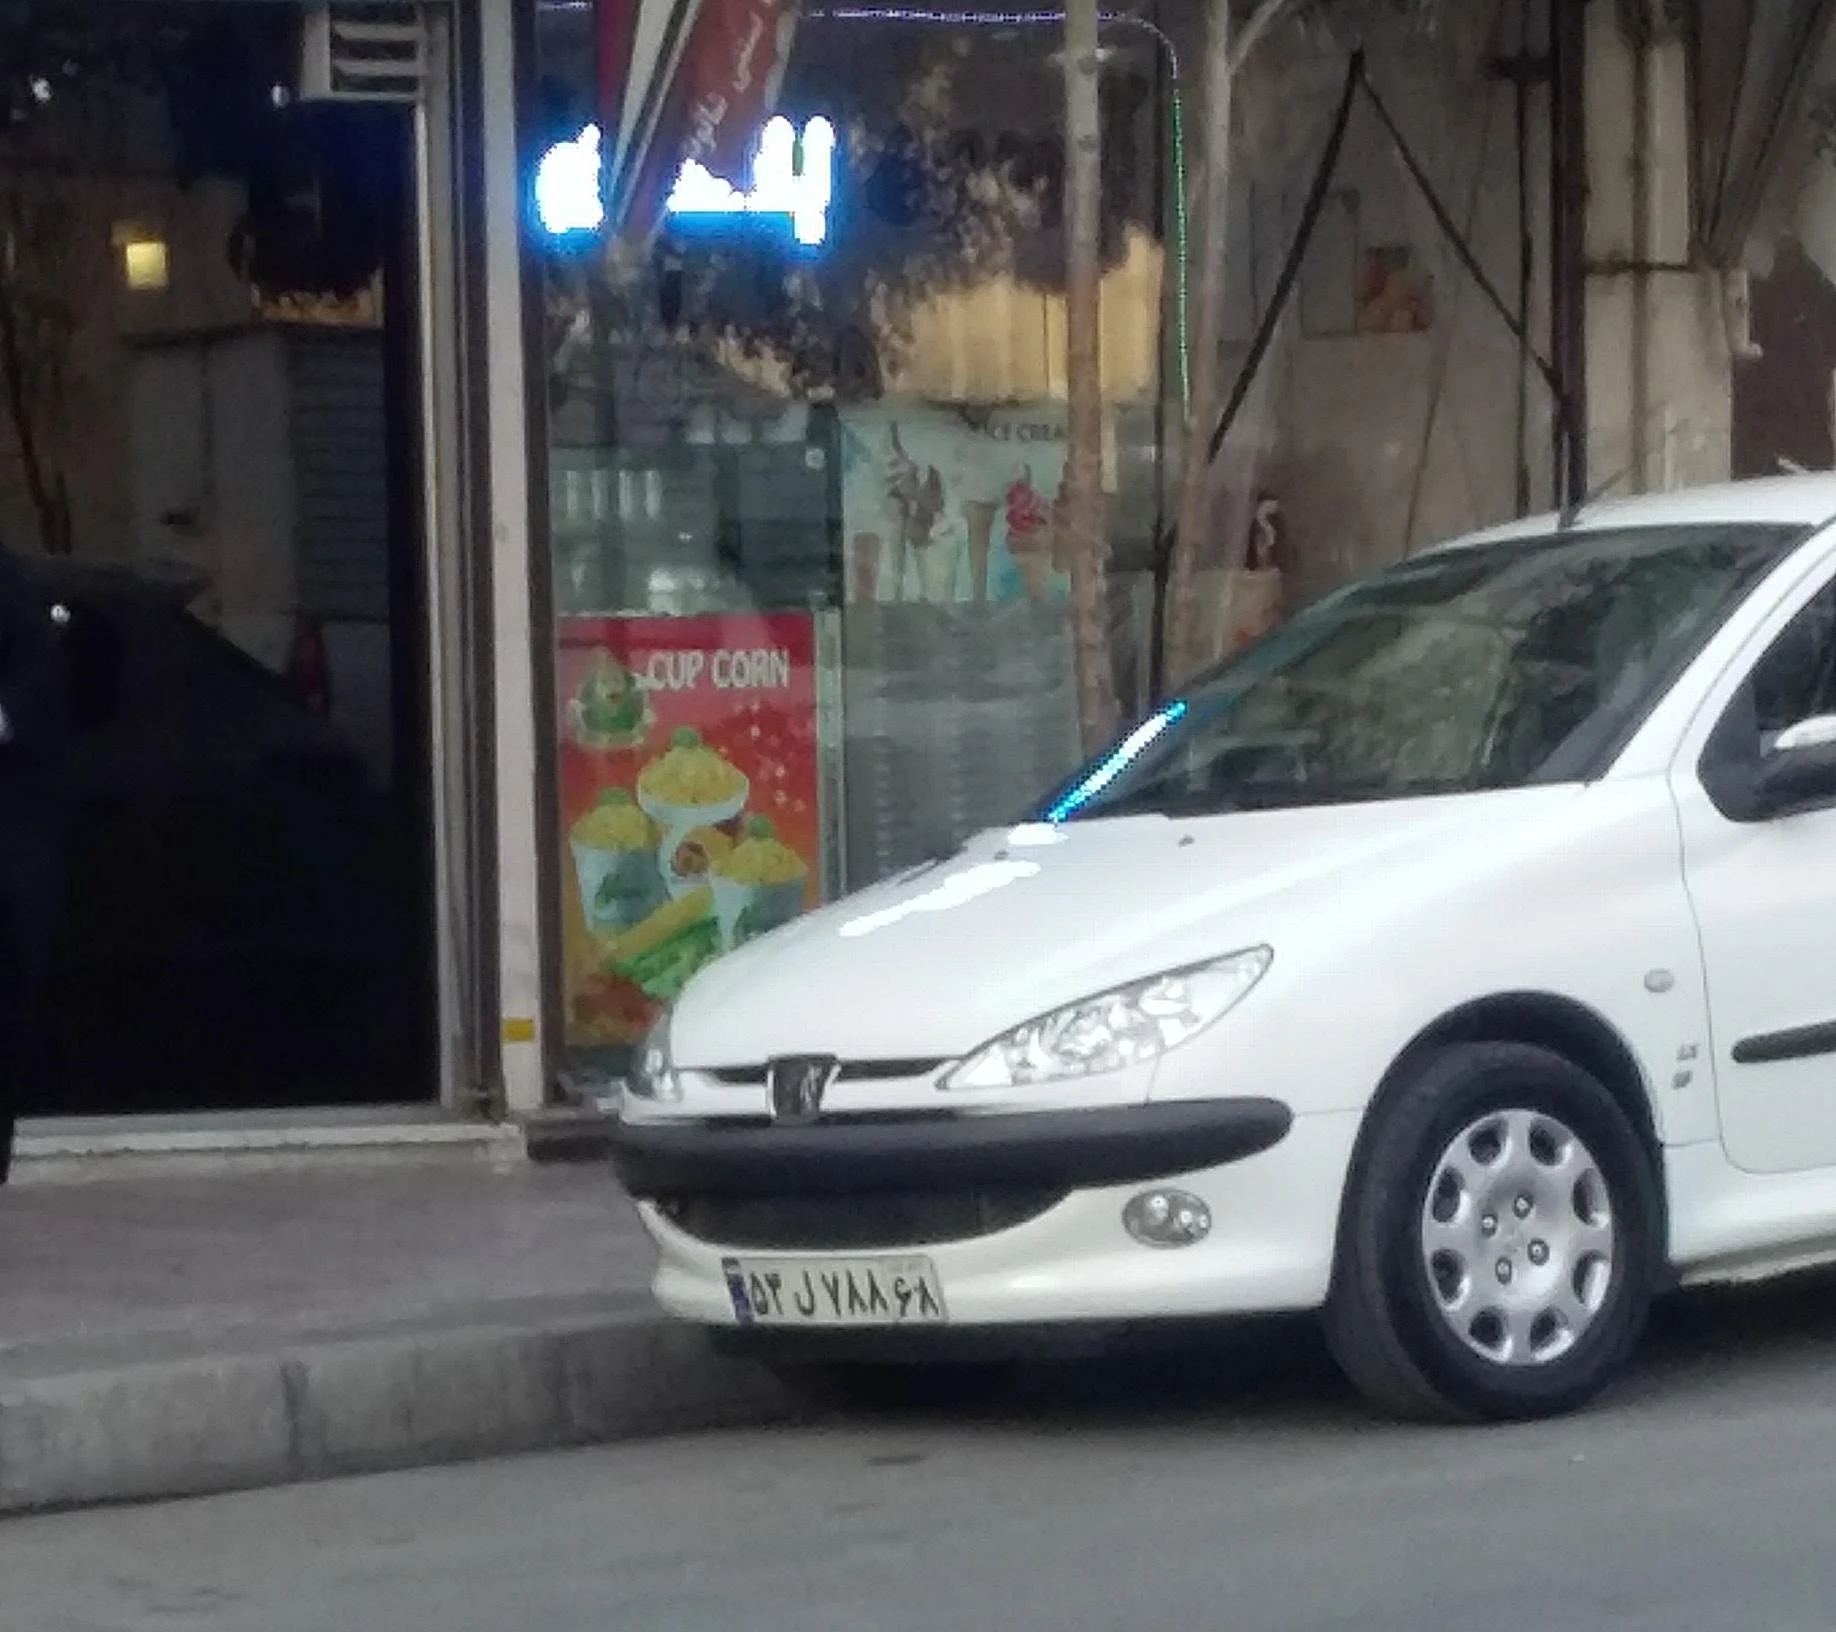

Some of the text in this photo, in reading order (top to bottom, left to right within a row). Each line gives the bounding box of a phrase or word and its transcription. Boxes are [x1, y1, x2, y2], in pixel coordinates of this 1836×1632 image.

[1015, 422, 1067, 442] CREA
[648, 648, 790, 690] CUP CORN
[894, 1275, 940, 1317] ۶۸
